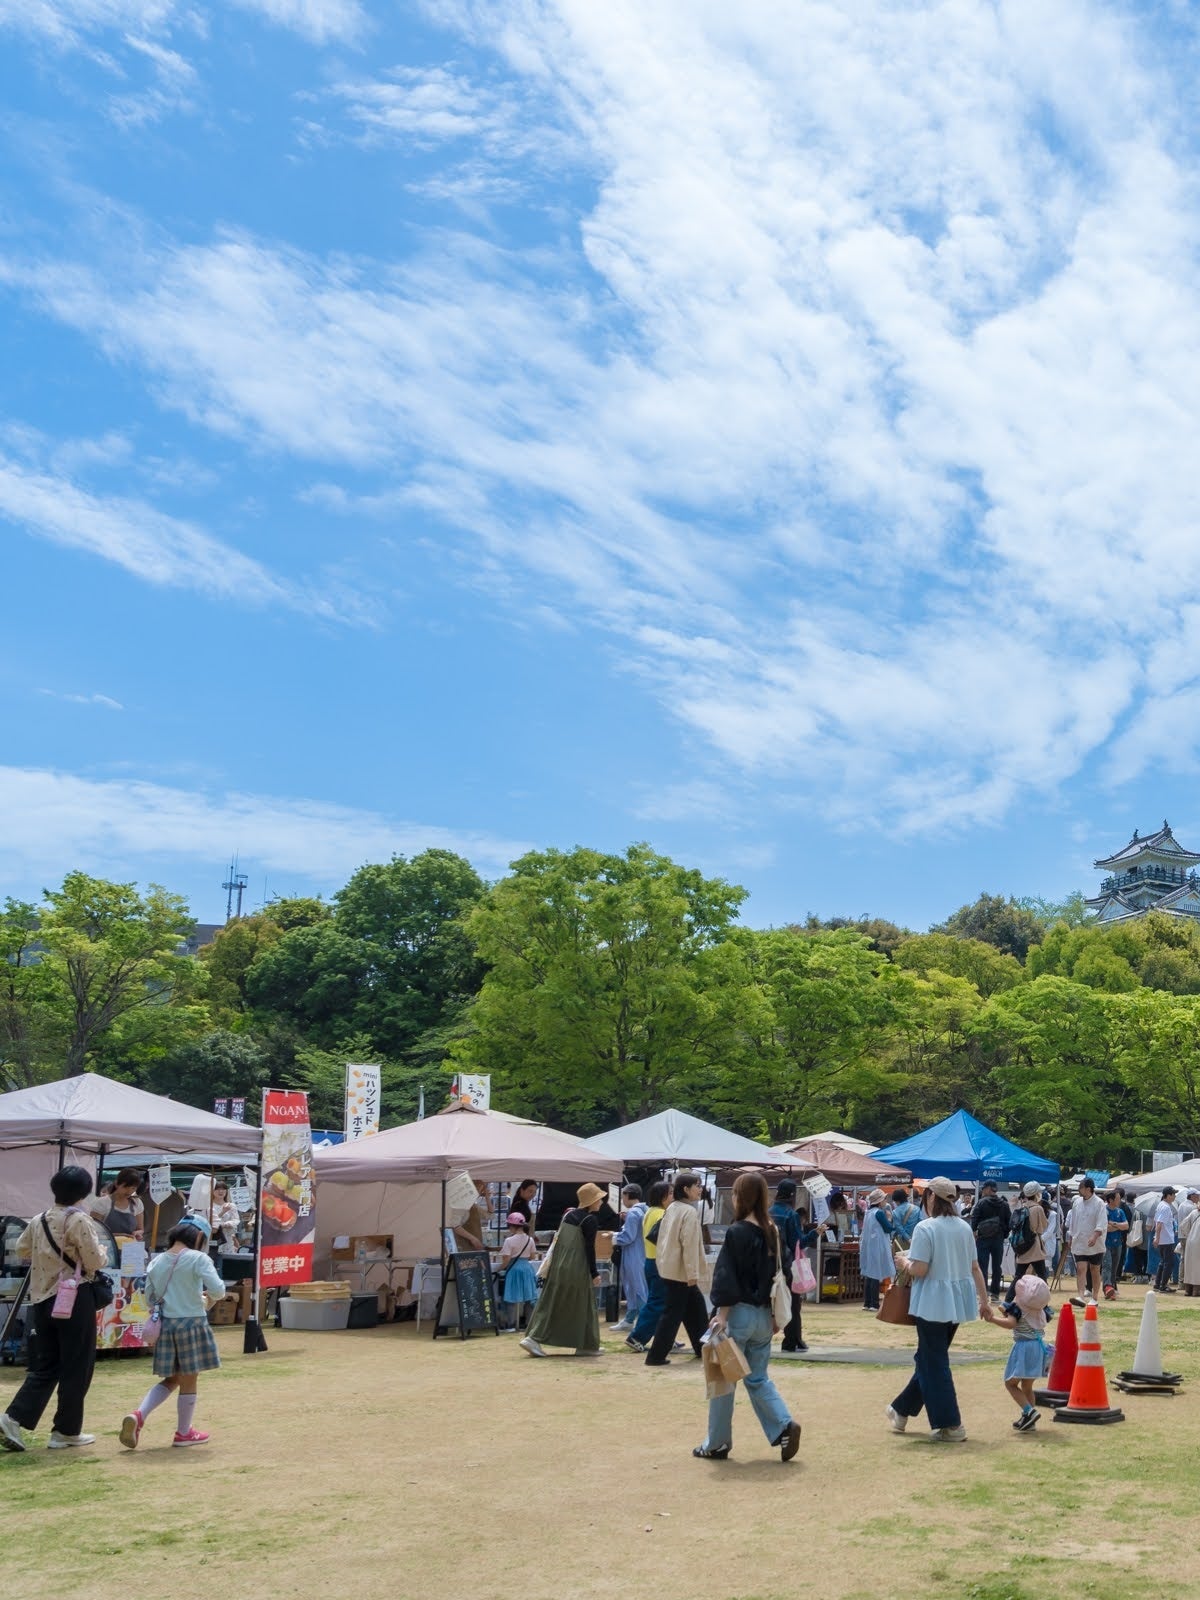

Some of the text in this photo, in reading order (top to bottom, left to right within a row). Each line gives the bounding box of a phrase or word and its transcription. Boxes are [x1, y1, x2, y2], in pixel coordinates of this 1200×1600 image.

[363, 1072, 378, 1080] mini
[364, 1080, 377, 1125] ハッシュド
[352, 1115, 364, 1140] ポテ
[262, 1255, 305, 1275] 営業中
